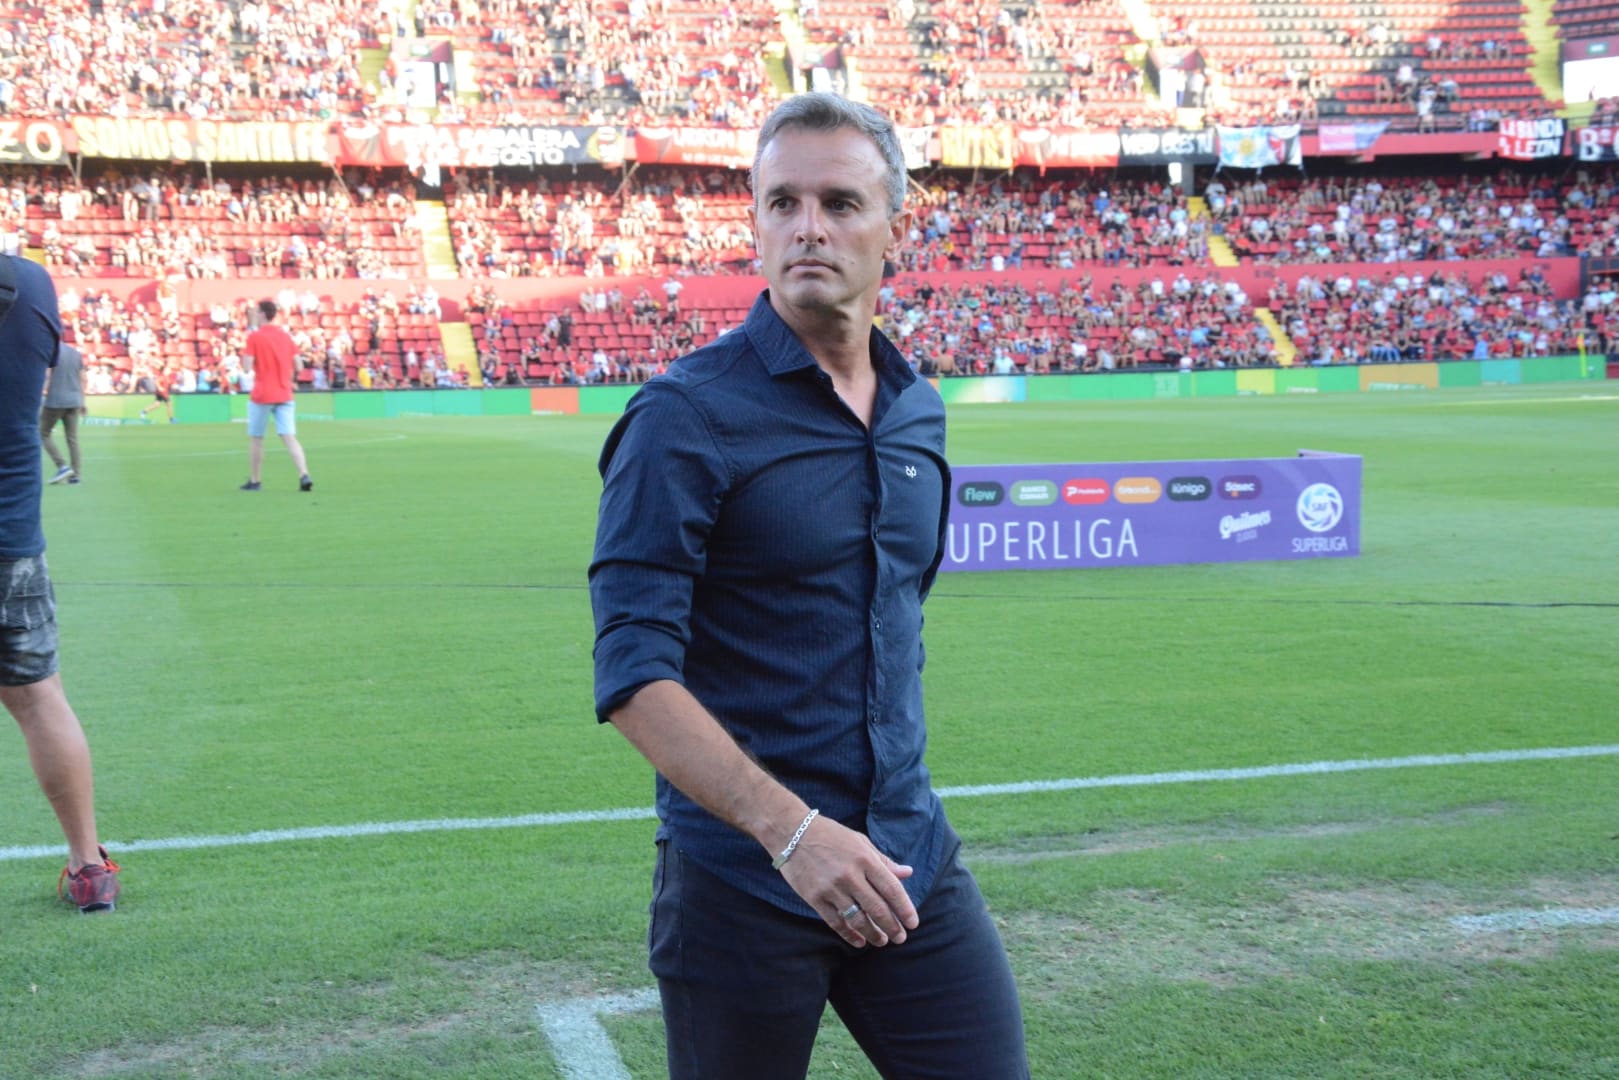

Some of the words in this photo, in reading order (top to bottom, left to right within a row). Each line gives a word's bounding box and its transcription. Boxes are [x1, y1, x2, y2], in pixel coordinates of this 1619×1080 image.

[73, 116, 193, 160] SOMOS
[197, 121, 295, 161] SANTA
[295, 121, 329, 162] FE
[458, 127, 580, 149] SABALERA
[464, 146, 565, 166] AGOSTO
[964, 487, 998, 502] flow
[949, 518, 1139, 564] UPERLIGA
[1291, 536, 1349, 553] SUPERLIGA
